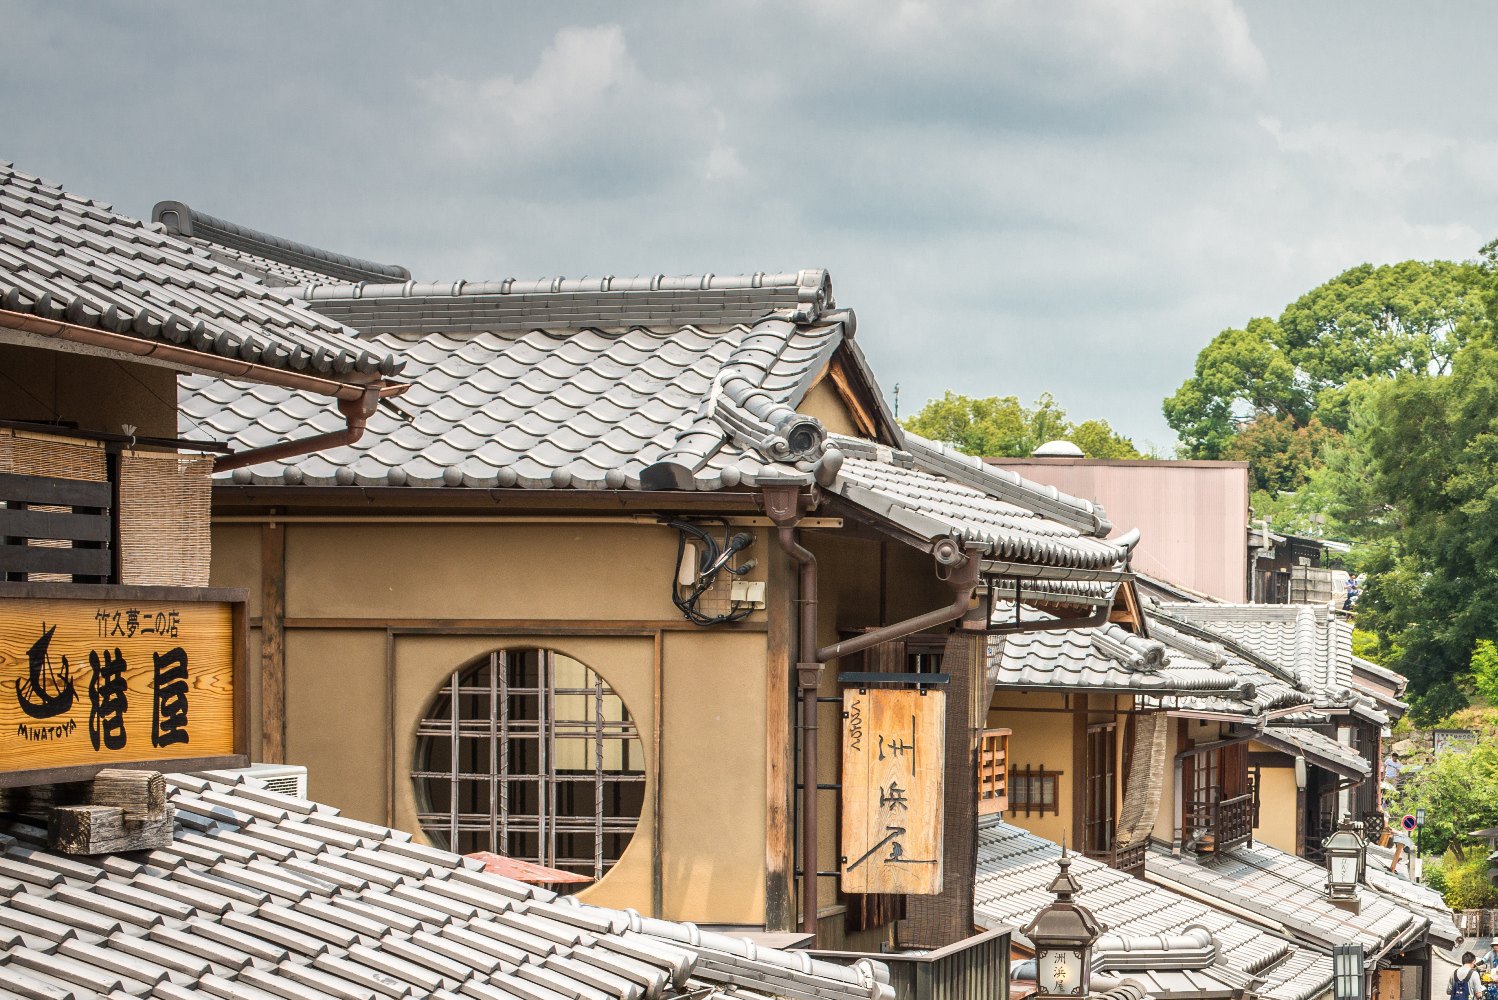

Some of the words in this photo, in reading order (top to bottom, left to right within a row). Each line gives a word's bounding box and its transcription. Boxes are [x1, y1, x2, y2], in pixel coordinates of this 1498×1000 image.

[95, 608, 180, 638] 竹久夢二の店
[88, 647, 189, 752] 港屋
[17, 718, 77, 741] MINATOYA
[1053, 952, 1067, 993] 洲浜屋
